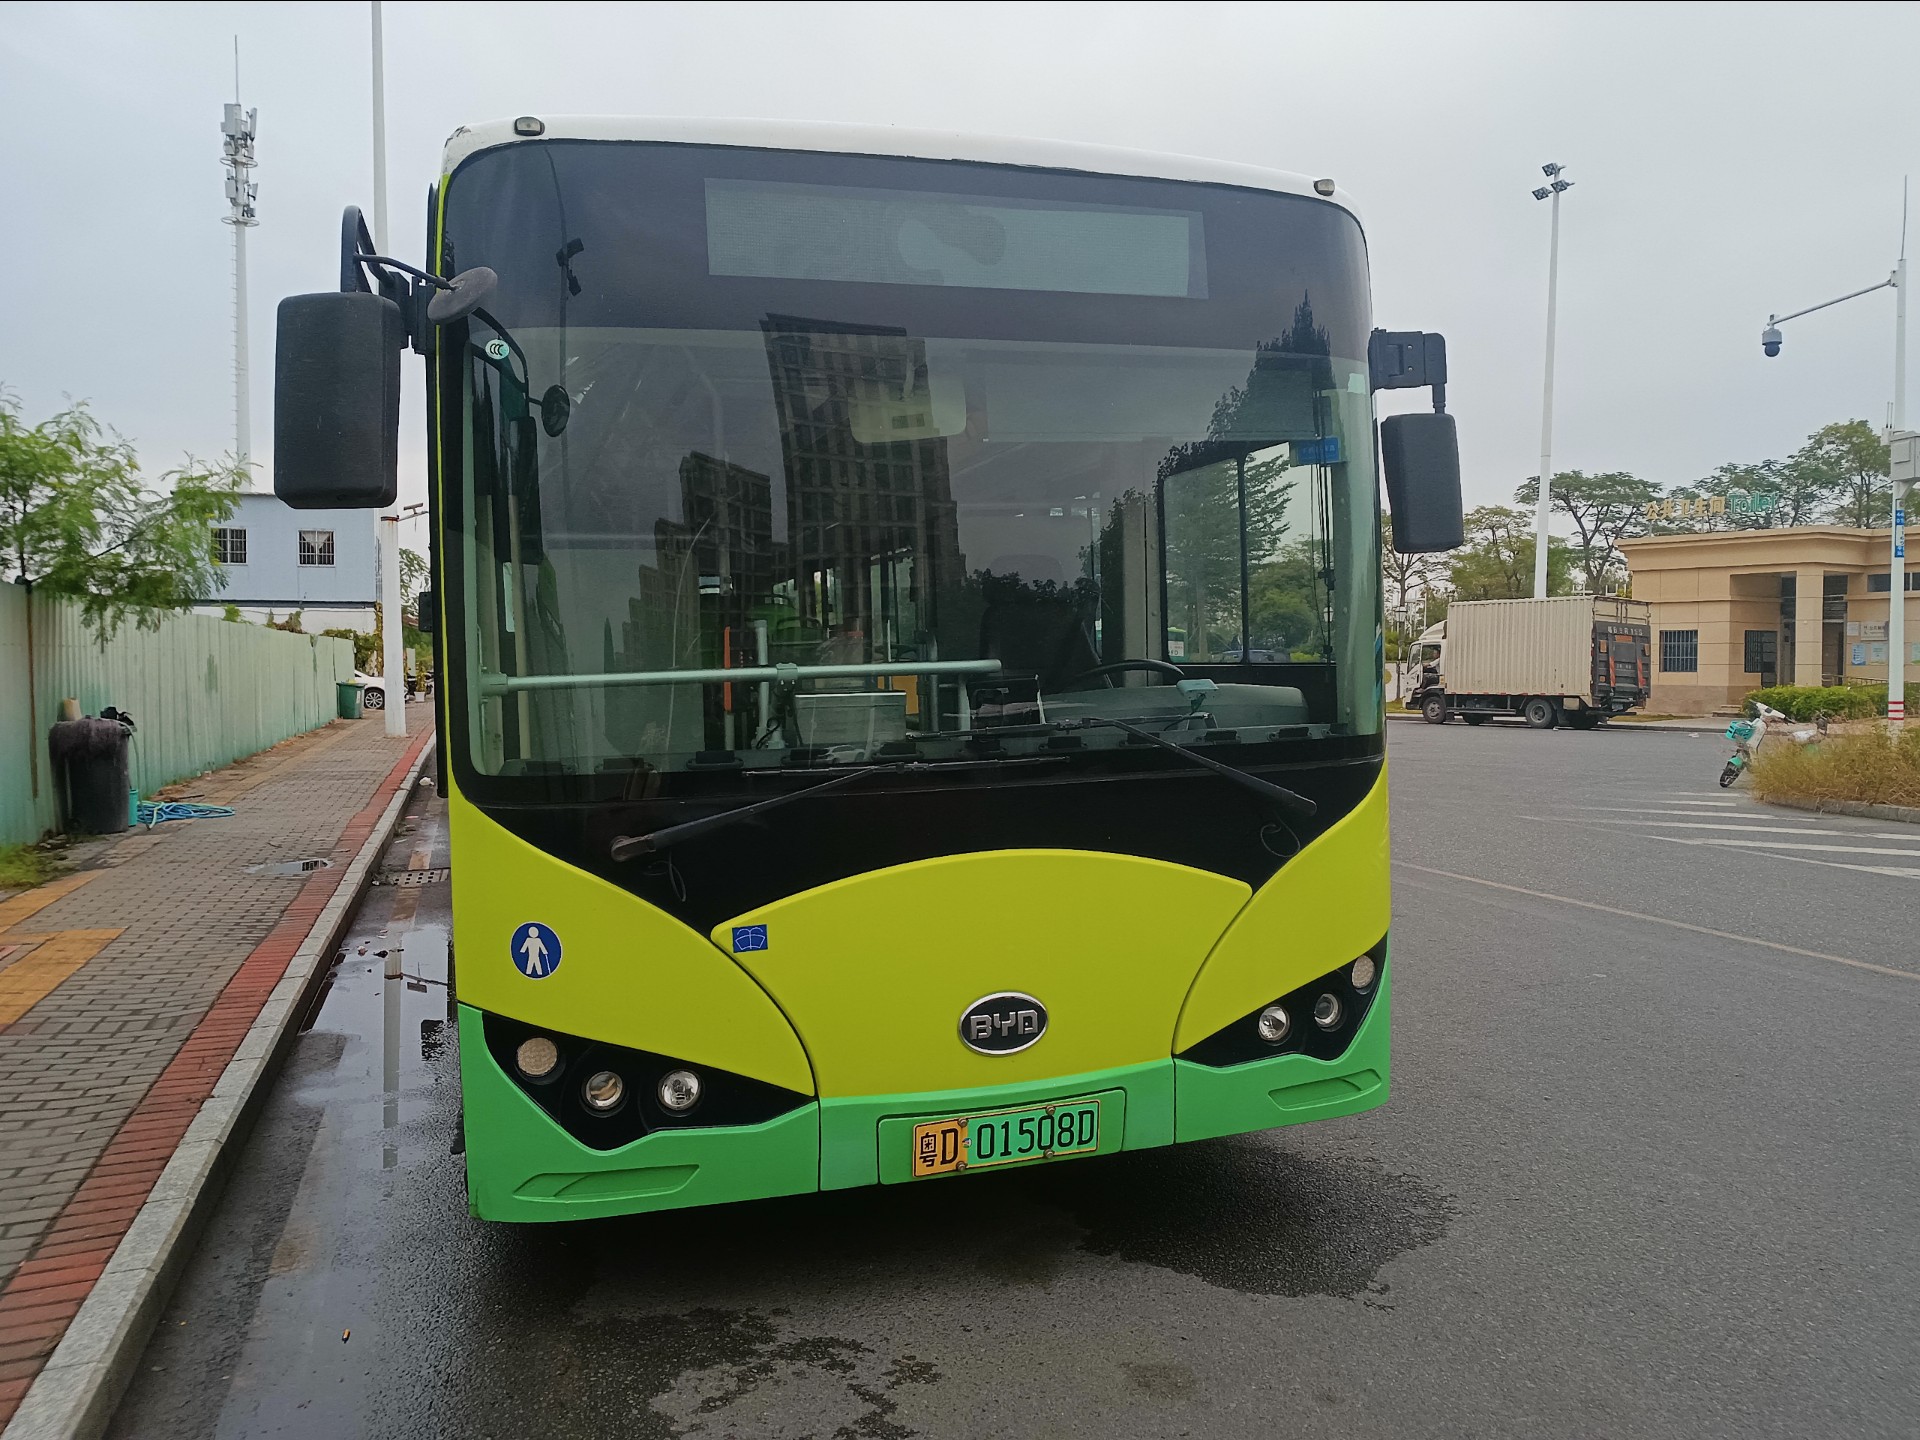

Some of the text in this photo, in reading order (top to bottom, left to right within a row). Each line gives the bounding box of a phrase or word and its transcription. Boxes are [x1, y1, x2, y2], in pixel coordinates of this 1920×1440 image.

[1646, 491, 1780, 520] 公共卫生间 Toilet
[970, 1009, 1038, 1040] BYD
